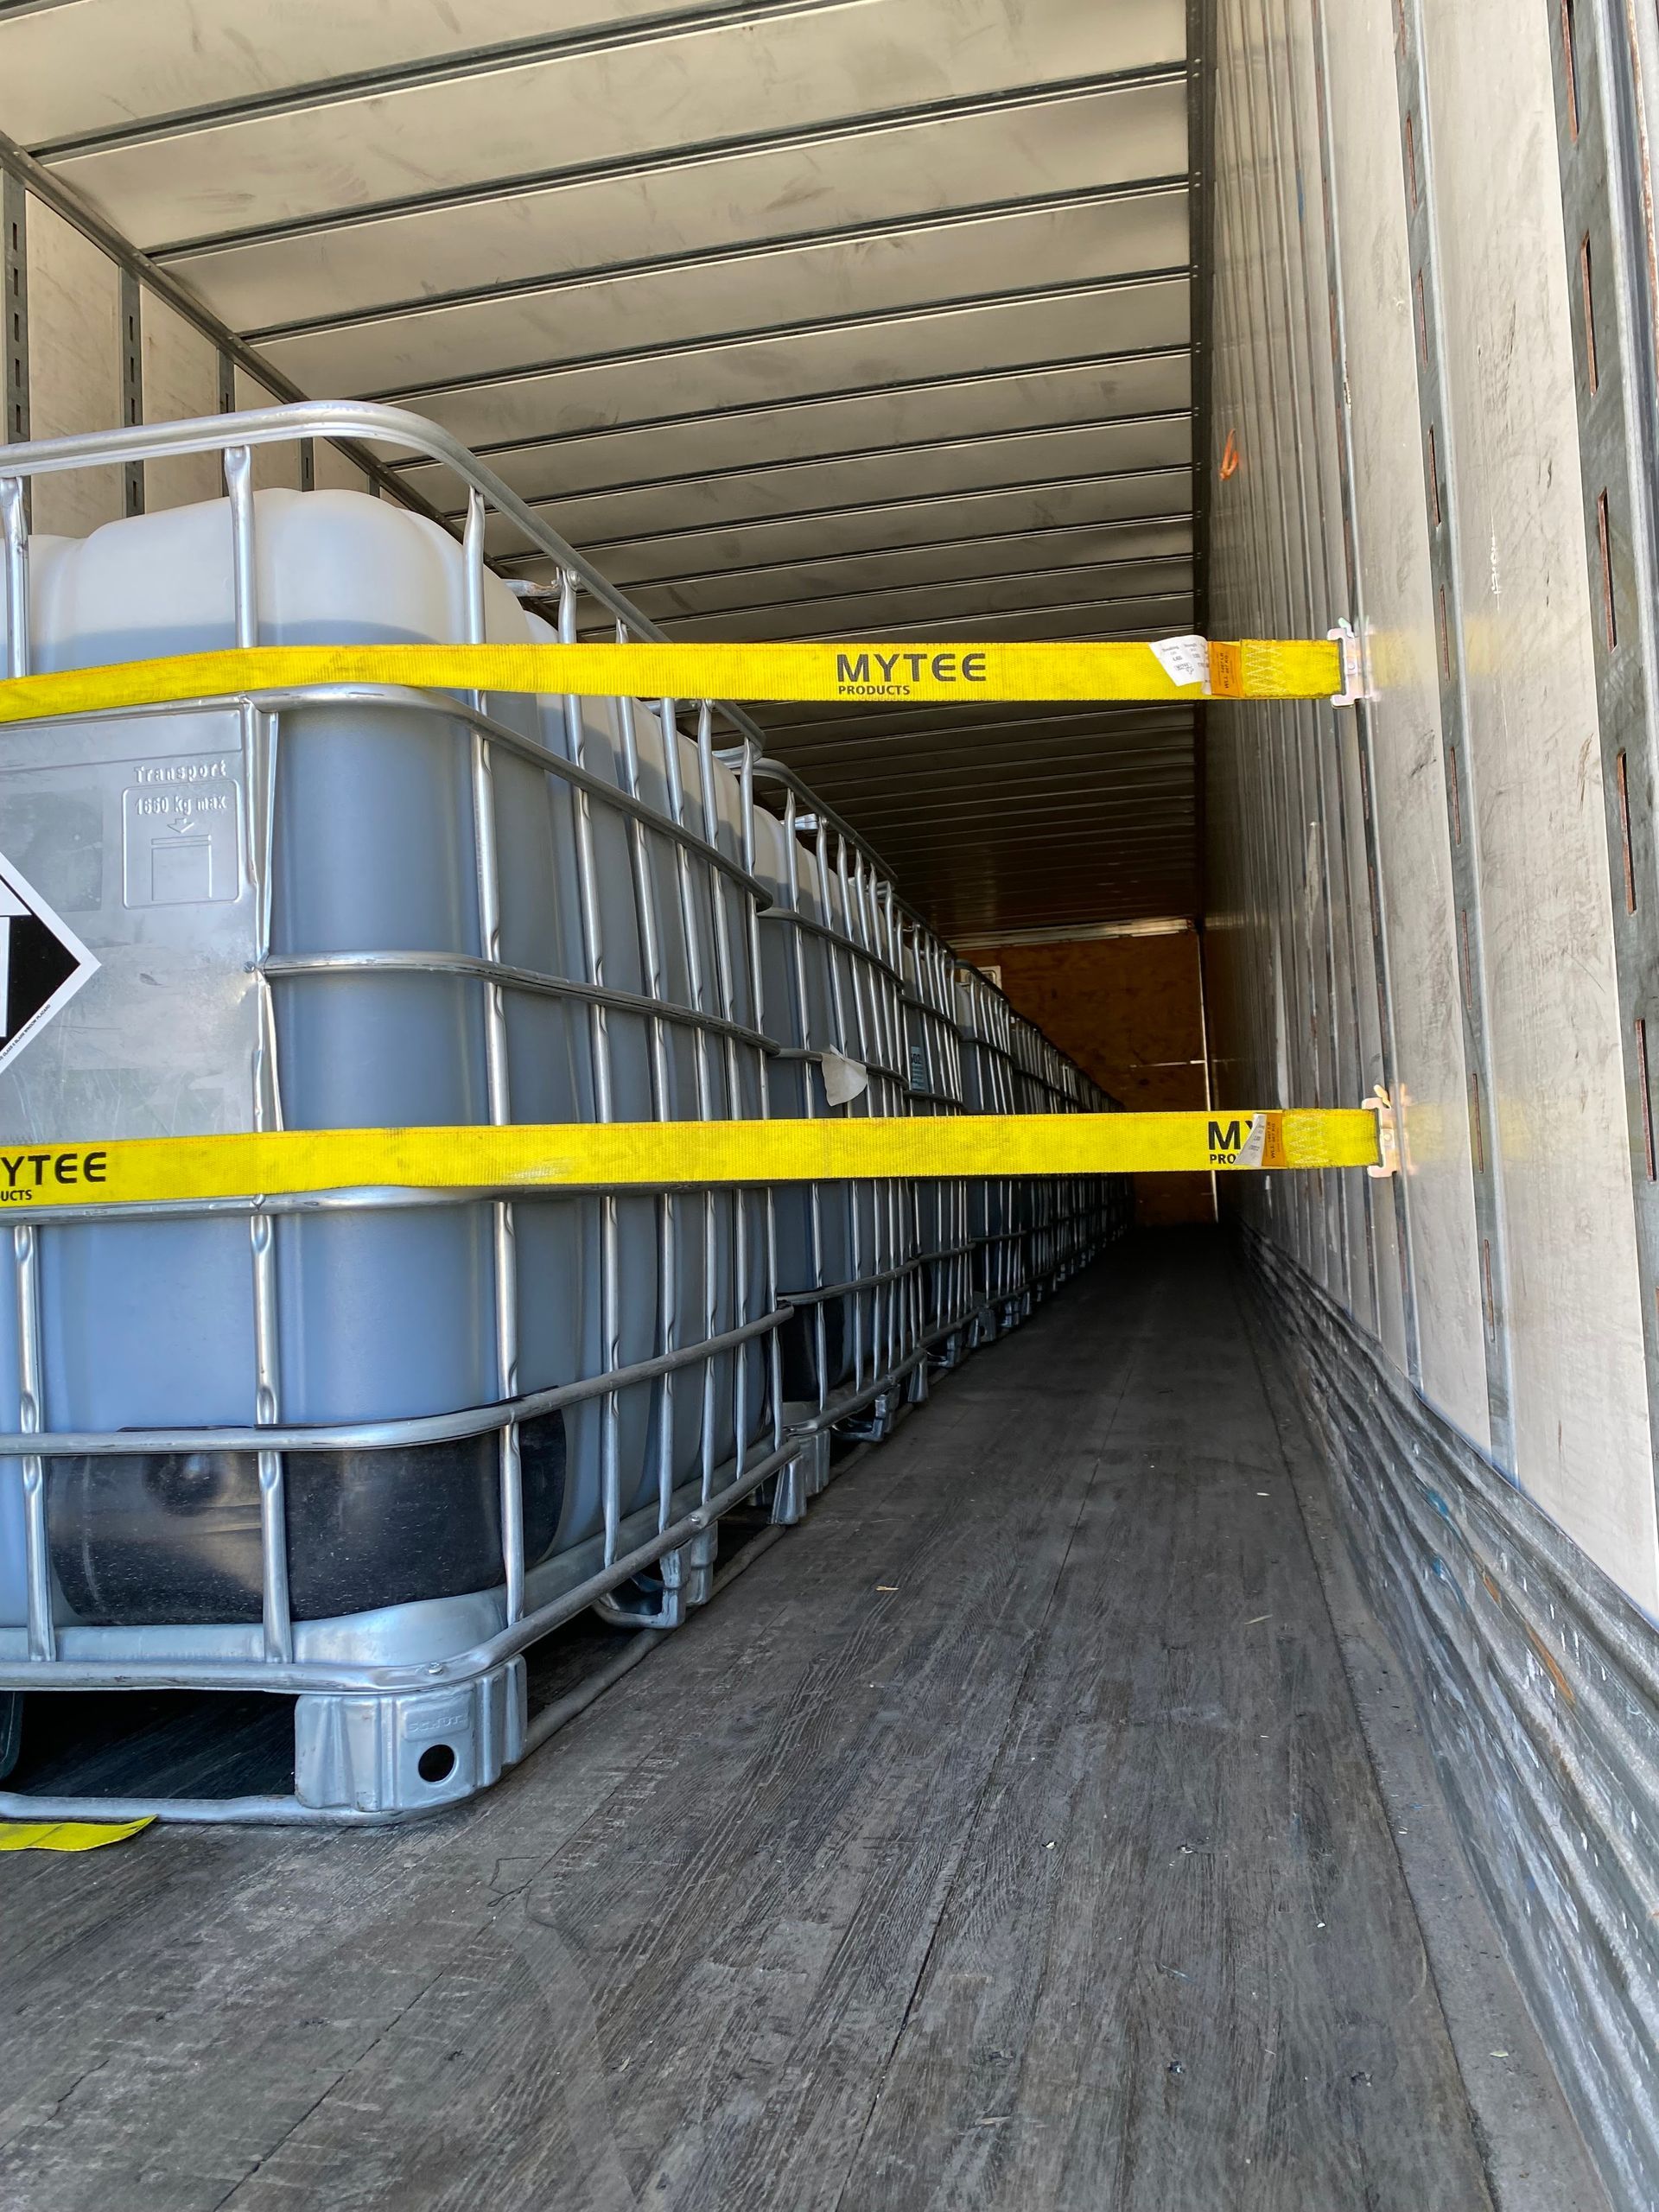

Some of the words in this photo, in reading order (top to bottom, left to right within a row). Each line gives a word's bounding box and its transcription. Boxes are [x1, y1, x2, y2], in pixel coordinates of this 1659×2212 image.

[836, 653, 987, 682] MYTEE
[838, 685, 911, 696] PRODUCTS
[134, 760, 226, 783] Transport
[174, 795, 192, 816] kg
[196, 795, 226, 810] max
[0, 1151, 106, 1187] YTEE
[1209, 1154, 1237, 1164] PRO
[0, 1189, 32, 1201] UCTS
